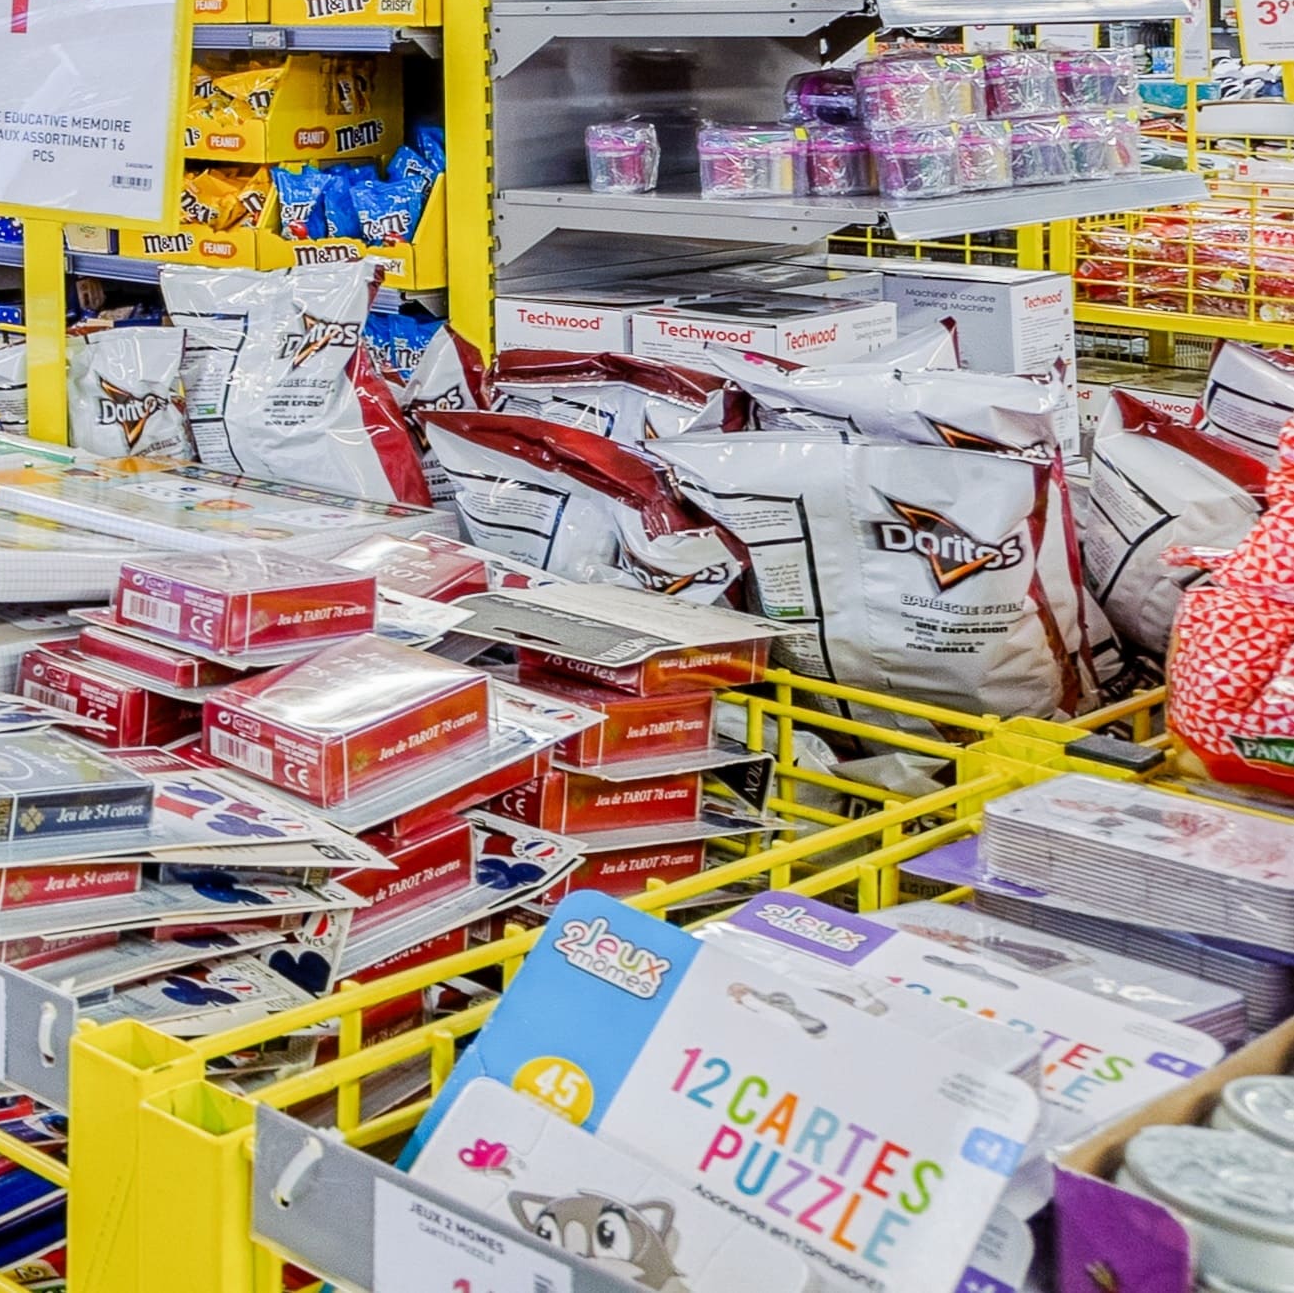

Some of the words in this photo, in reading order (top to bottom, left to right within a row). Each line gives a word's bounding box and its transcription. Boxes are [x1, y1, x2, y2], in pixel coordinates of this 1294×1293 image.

[3, 110, 68, 128] EDUCATIVE
[71, 116, 132, 134] MEMOIRE
[21, 130, 108, 149] ASSORTIMENT
[111, 137, 126, 152] 16
[32, 149, 56, 164] PCS
[904, 287, 948, 300] Machine
[959, 291, 996, 304] coudre
[950, 302, 995, 314] Machine
[1022, 289, 1064, 311] Techwood
[516, 308, 604, 331] Techwood
[655, 320, 756, 345] Techwood
[784, 322, 840, 351] Techwood
[880, 522, 1024, 569] Doritos
[378, 746, 396, 762] Jeu
[408, 727, 440, 752] TAROT
[441, 720, 452, 735] 78
[452, 710, 478, 730] cartes
[649, 721, 674, 737] TAROT
[624, 789, 652, 804] TAROT
[653, 787, 664, 801] 78
[665, 786, 688, 801] cartes
[55, 807, 76, 824] Jeu
[77, 806, 93, 822] de
[95, 805, 108, 822] 54
[109, 800, 144, 818] cartes
[599, 861, 617, 877] Jeu
[629, 856, 659, 872] TAROT
[659, 854, 669, 867] 78
[670, 850, 694, 865] cartes
[42, 876, 62, 893] Jeu
[64, 874, 78, 890] de
[80, 872, 96, 889] 54
[97, 868, 130, 886] cartes
[388, 874, 422, 898] TAROT
[423, 866, 434, 883] 78
[434, 857, 462, 878] cartes
[557, 923, 589, 955] 2
[581, 919, 669, 983] Jeux
[572, 946, 655, 996] mômes
[534, 1064, 585, 1108] 45
[671, 1046, 732, 1109] 12
[726, 1074, 946, 1216] CARTES
[692, 1182, 766, 1231] Apprends
[697, 1123, 912, 1270] PUZZLE
[410, 1201, 441, 1227] JEUX
[444, 1217, 453, 1231] 2
[455, 1223, 506, 1255] MOMES
